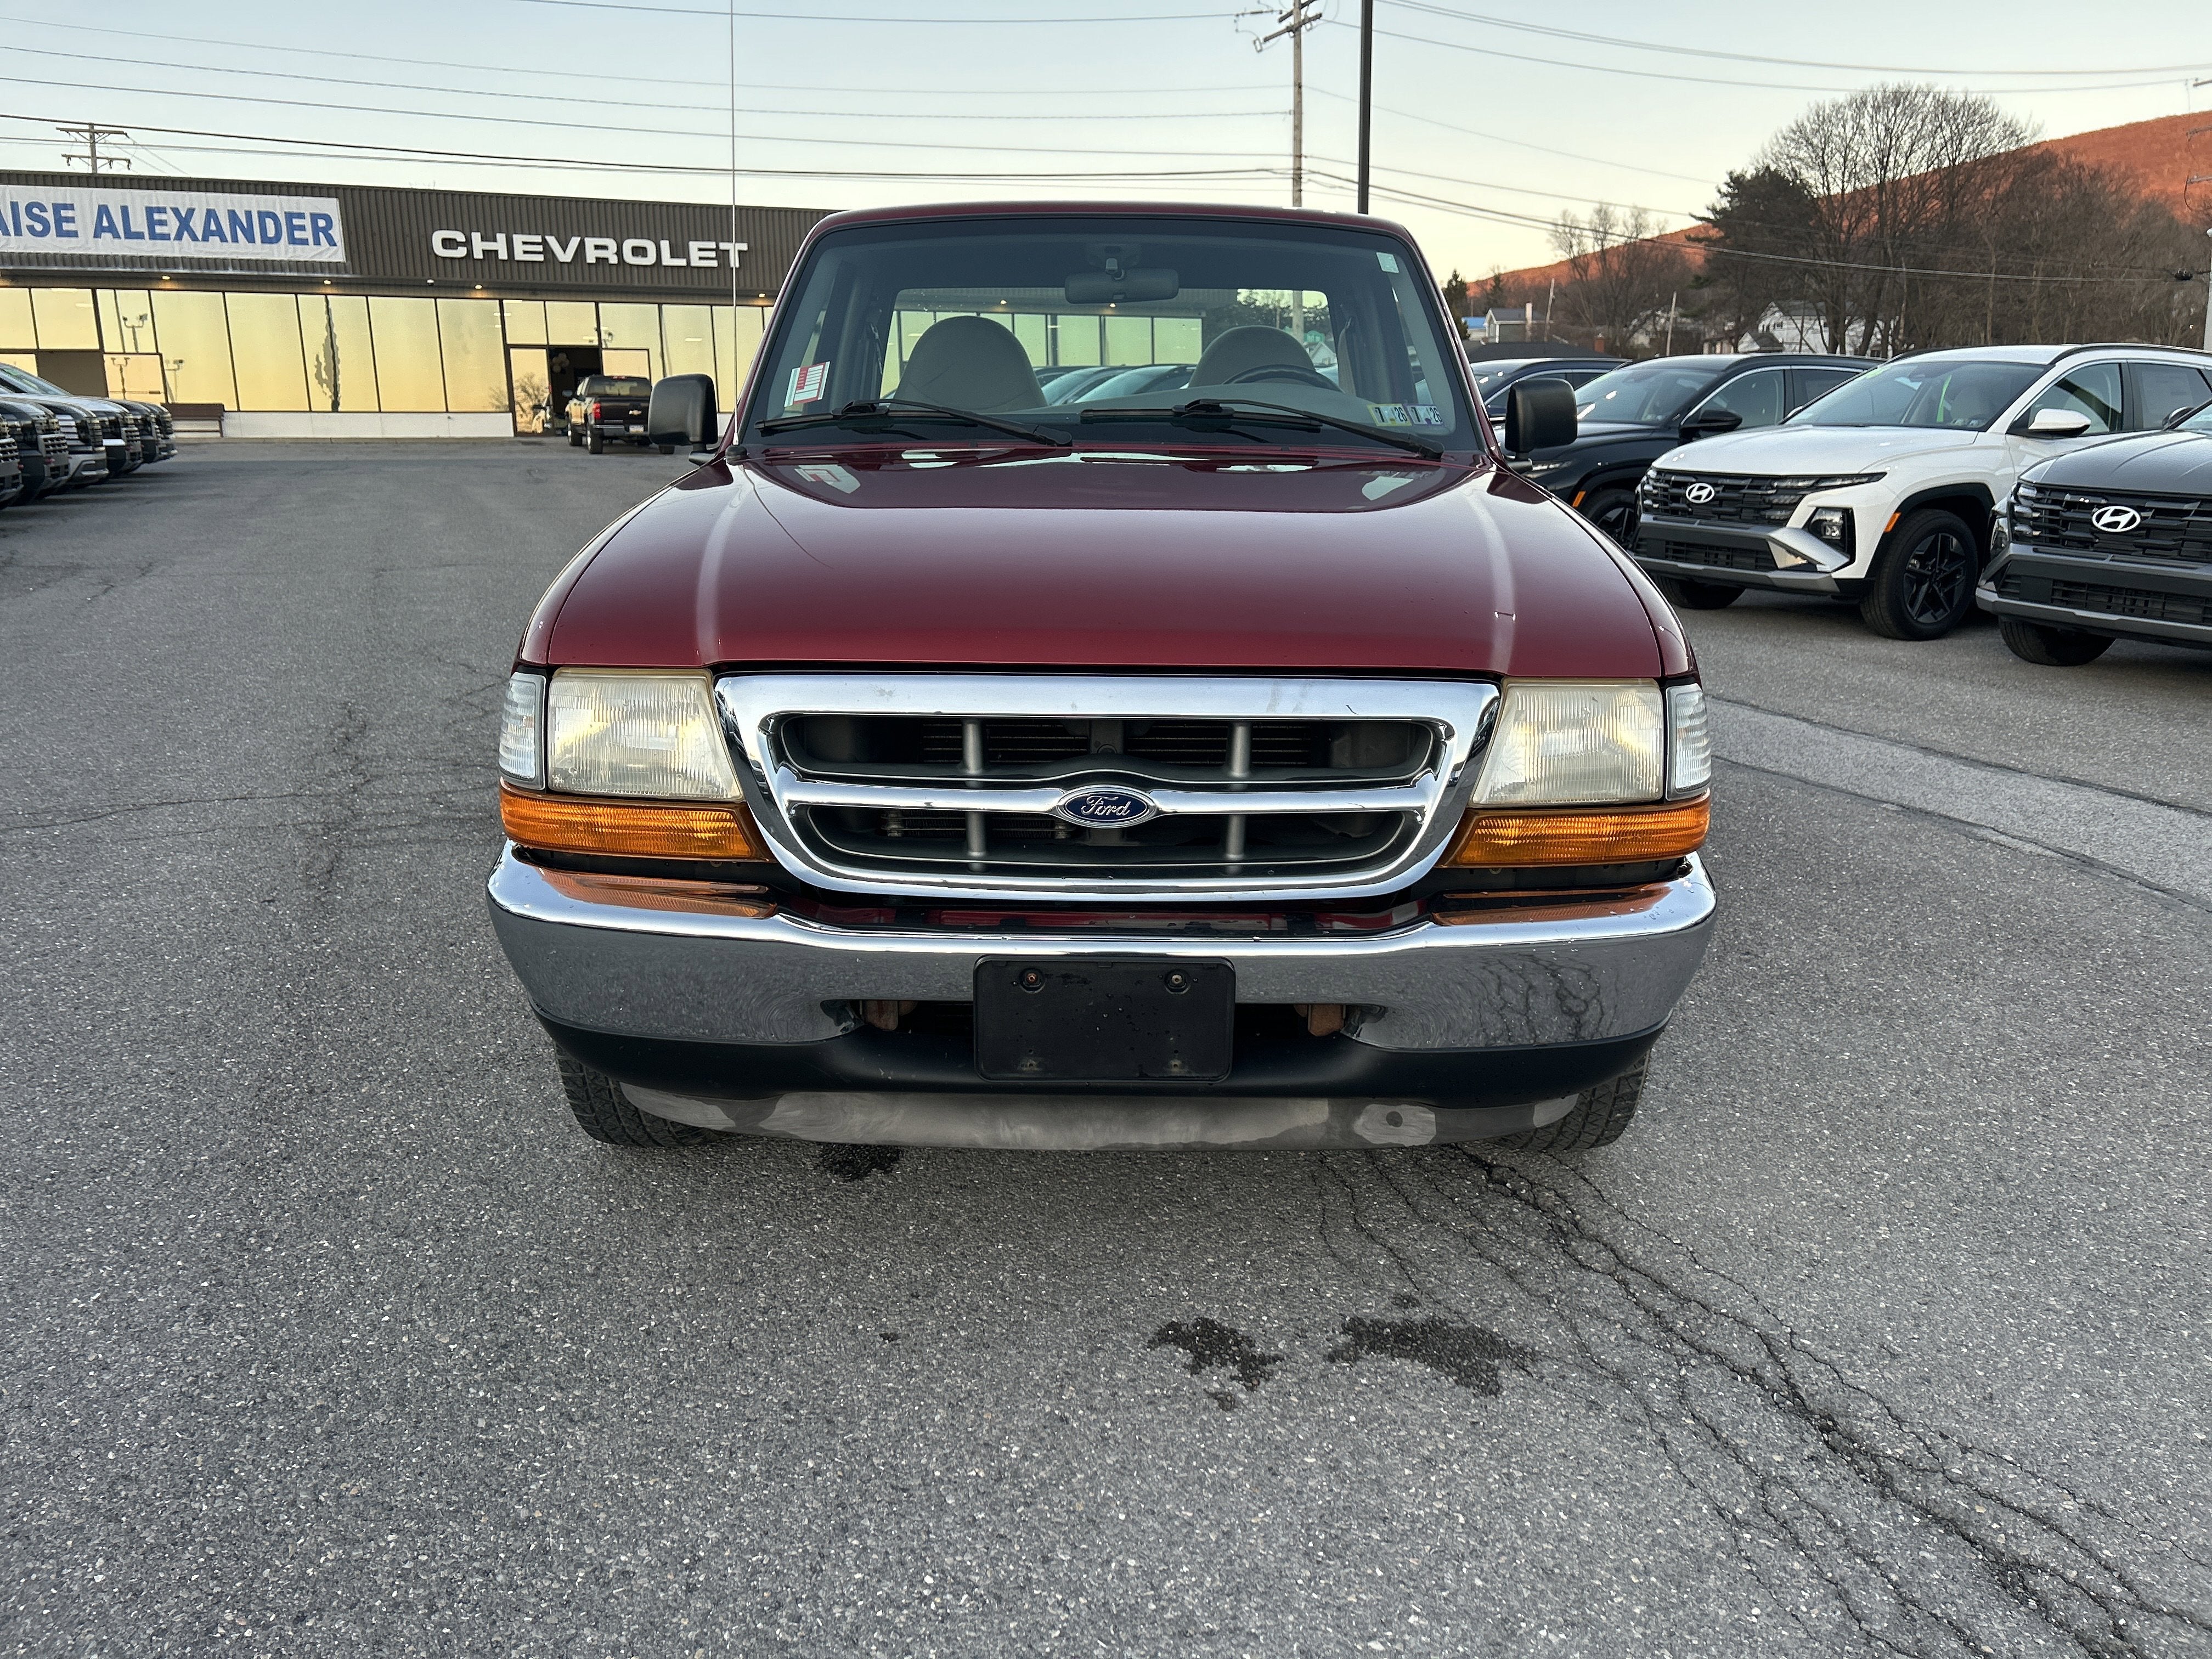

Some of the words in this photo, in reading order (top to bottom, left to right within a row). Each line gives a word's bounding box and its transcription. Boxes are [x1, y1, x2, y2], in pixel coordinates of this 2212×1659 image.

[93, 204, 337, 246] ALEXANDER
[431, 229, 748, 268] CHEVROLET
[1394, 407, 1408, 422] 26
[1430, 407, 1442, 422] 26
[1081, 795, 1131, 816] Ford
